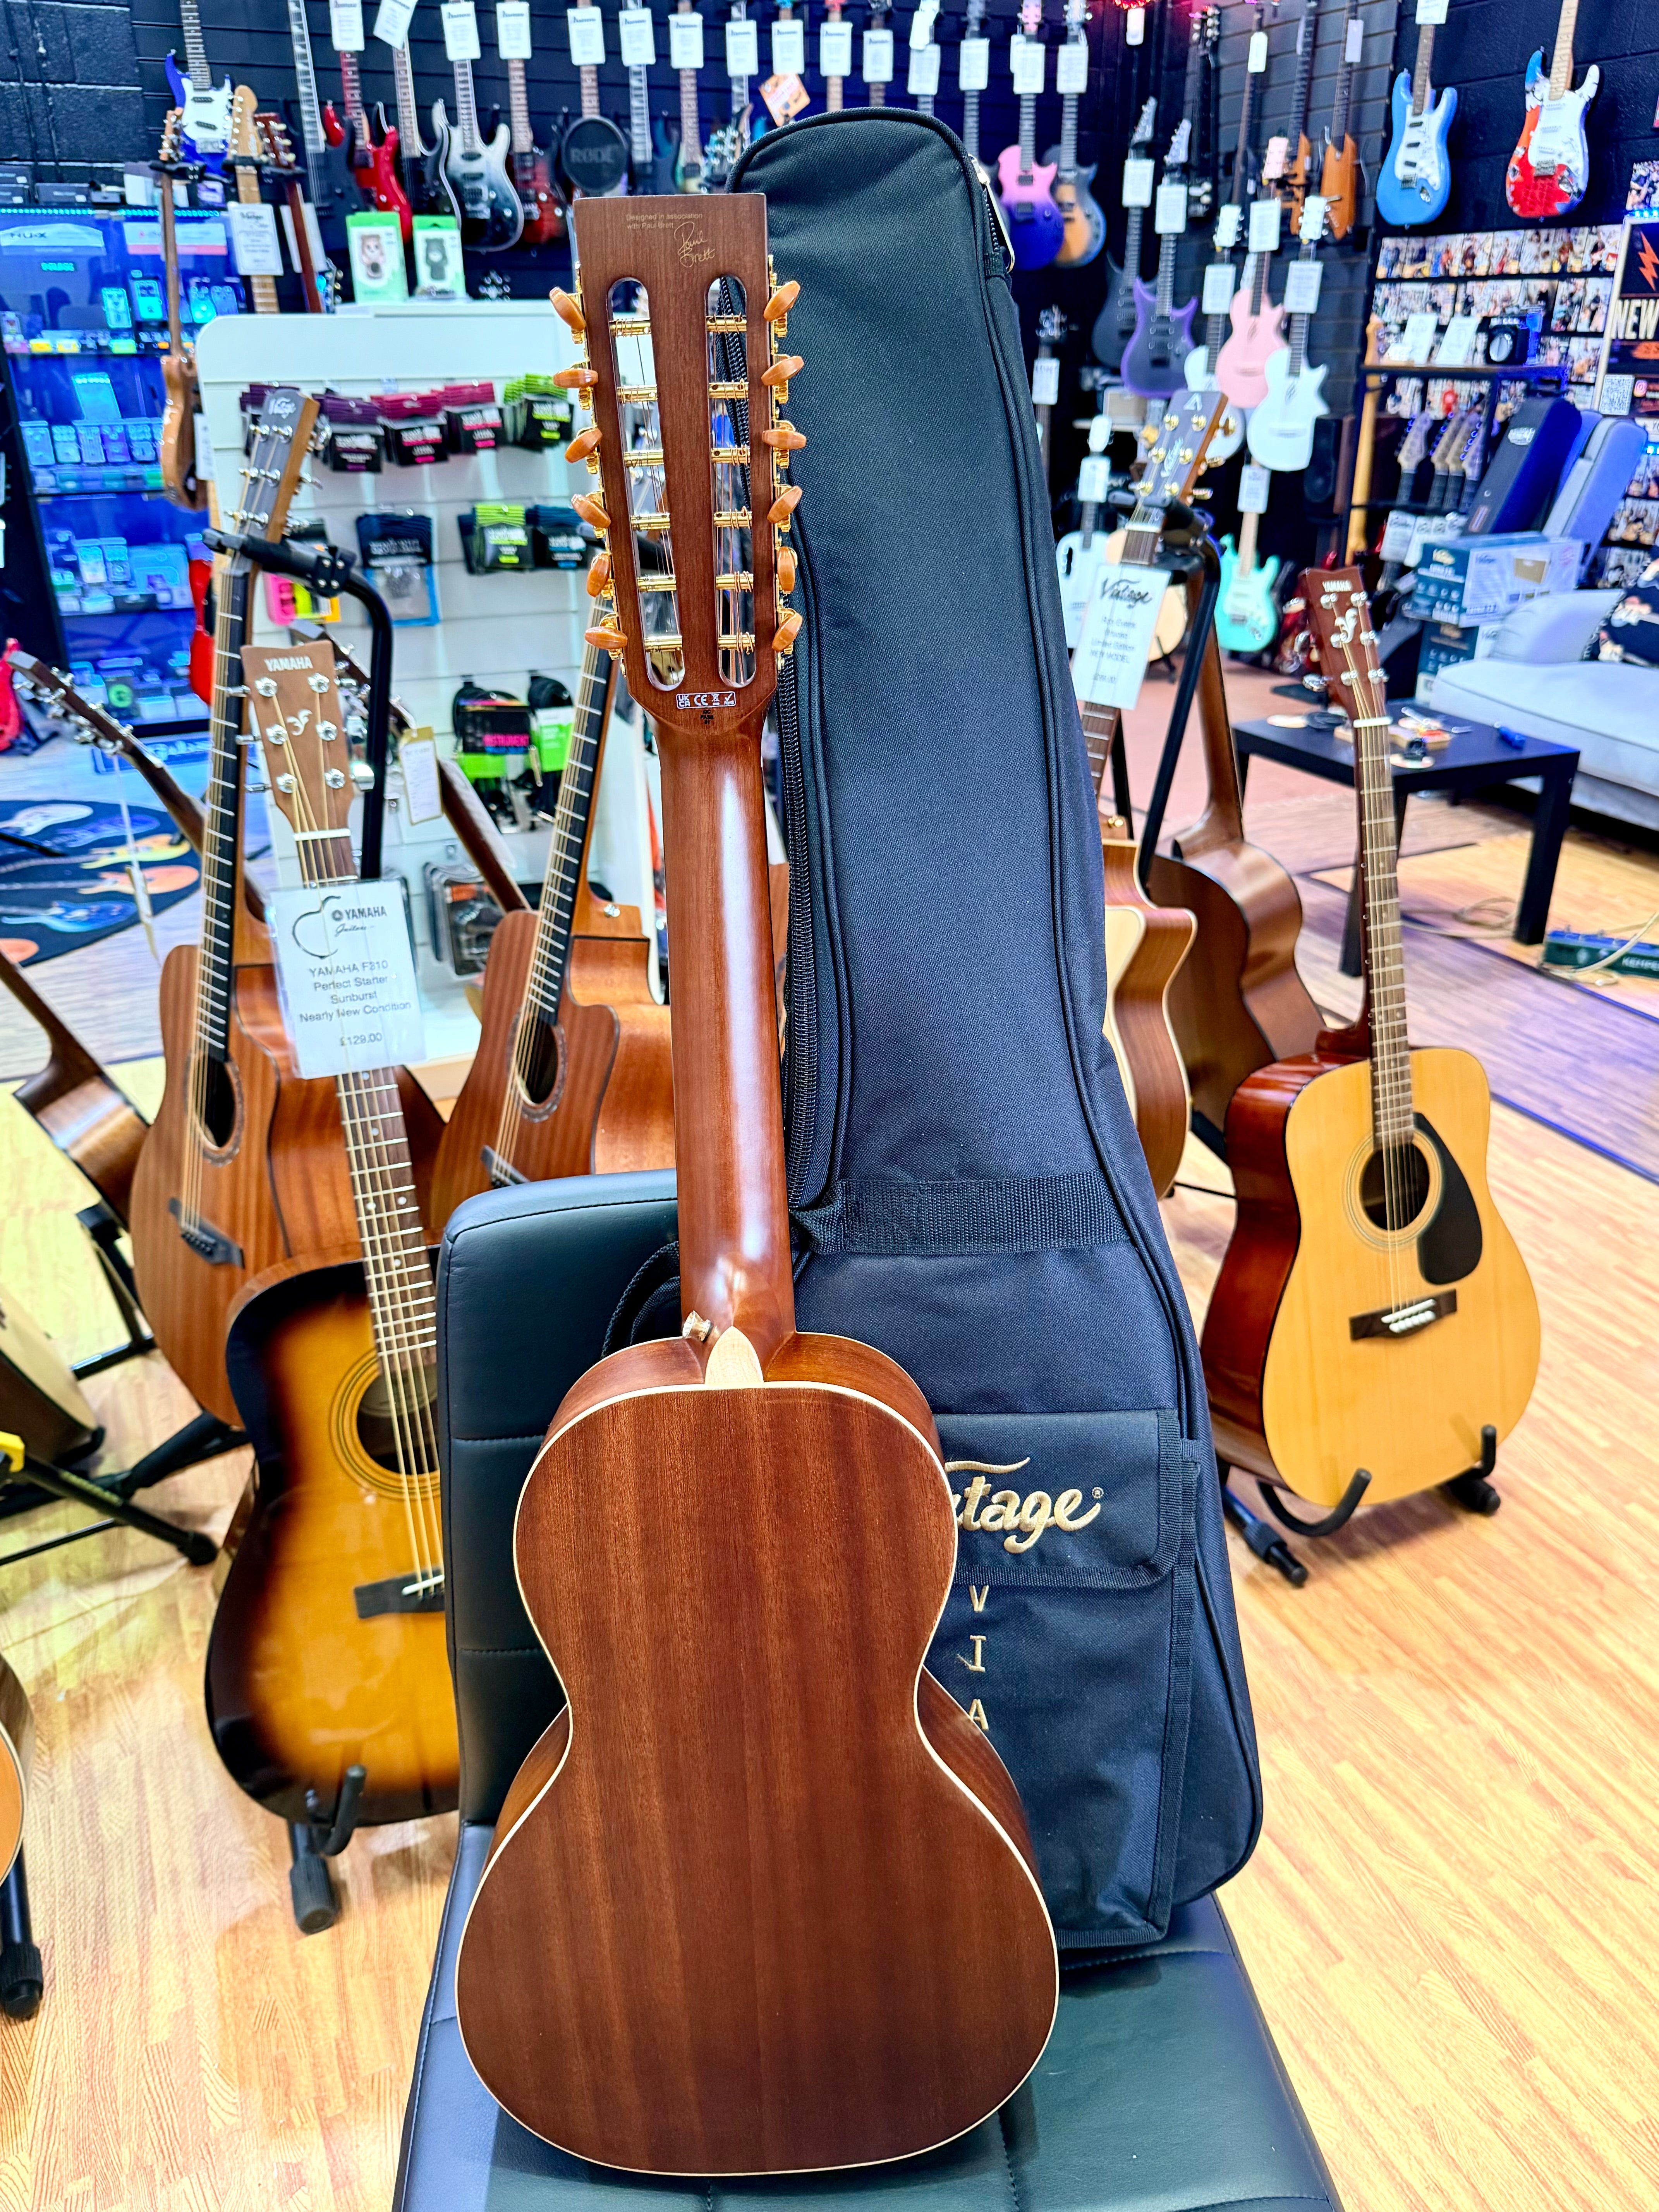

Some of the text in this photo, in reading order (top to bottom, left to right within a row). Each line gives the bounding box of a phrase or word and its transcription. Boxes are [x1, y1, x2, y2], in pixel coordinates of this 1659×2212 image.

[626, 214, 657, 222] Designed
[1611, 299, 1659, 340] NEW
[1322, 580, 1353, 592] YAMAHA
[264, 656, 313, 672] YAMAHA
[694, 694, 708, 706] CE
[345, 906, 387, 920] YAMAHA
[309, 963, 359, 977] YAMAHA
[313, 976, 388, 991] Perfect Starter
[330, 991, 378, 1004] Sunburst
[299, 1001, 412, 1022] Nearly New Condition
[944, 1457, 1101, 1554] tage
